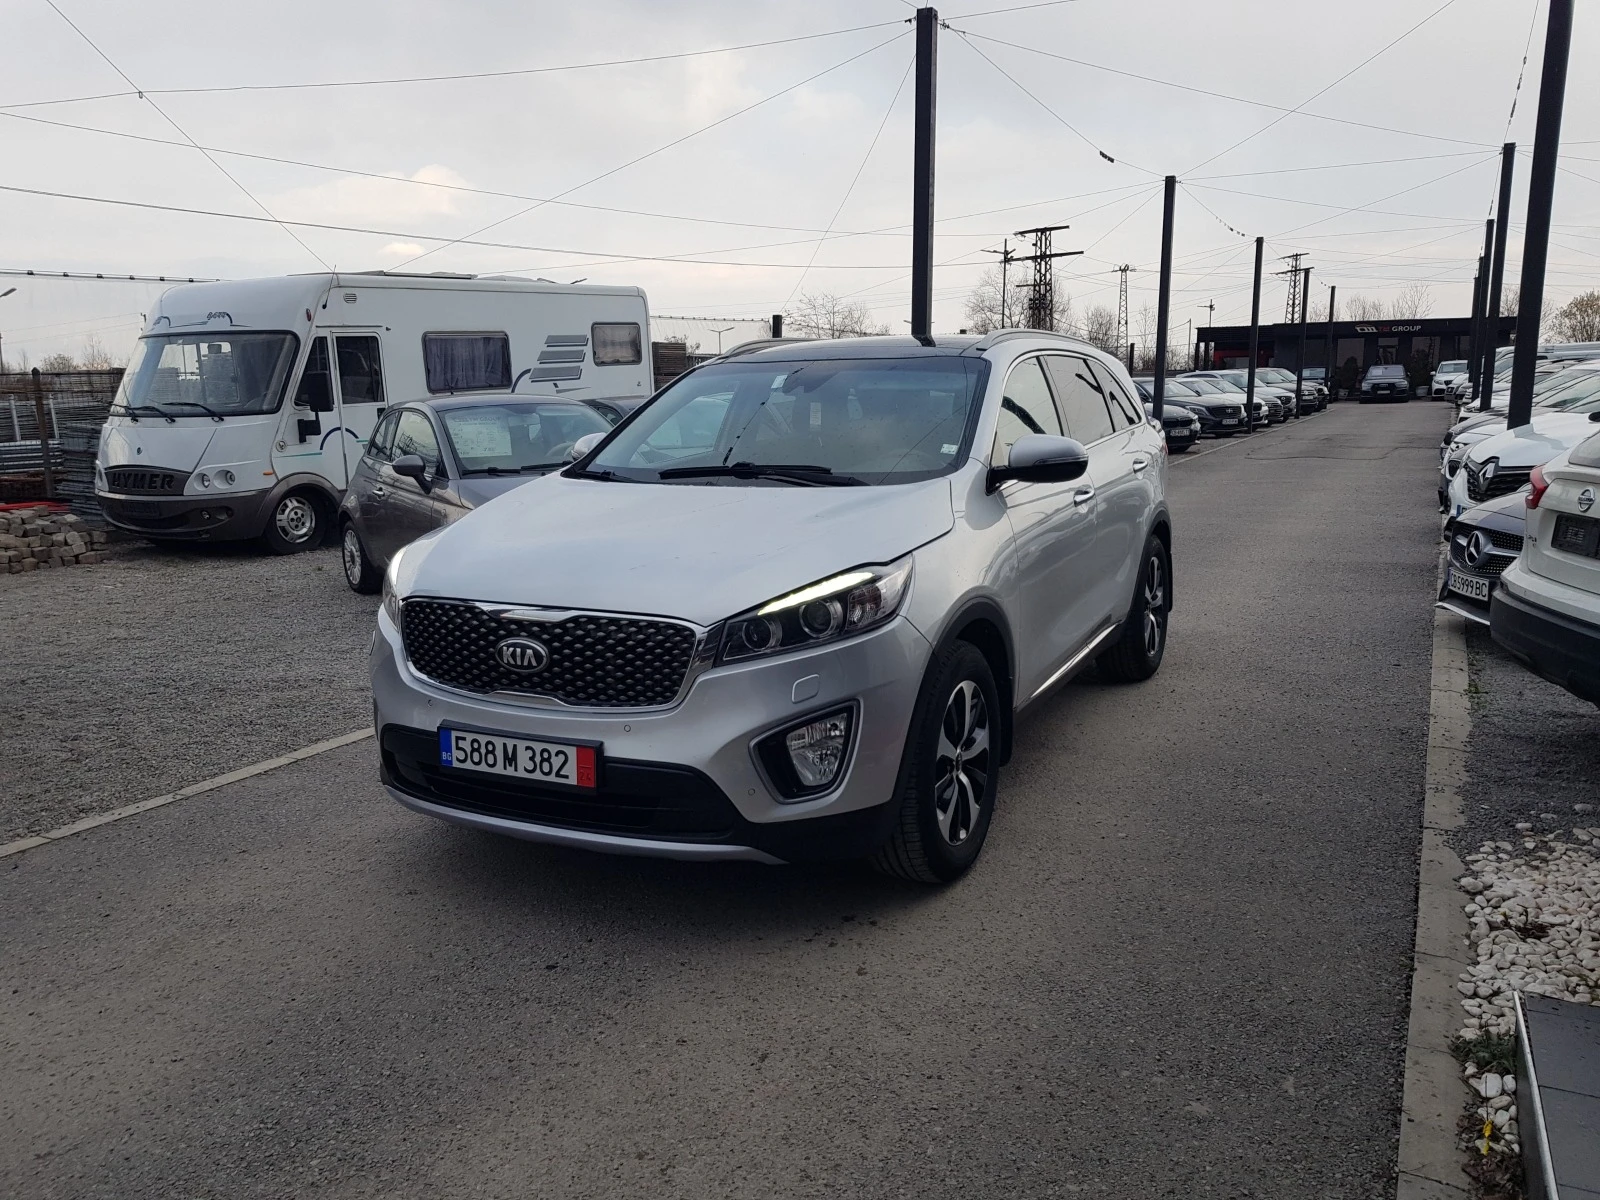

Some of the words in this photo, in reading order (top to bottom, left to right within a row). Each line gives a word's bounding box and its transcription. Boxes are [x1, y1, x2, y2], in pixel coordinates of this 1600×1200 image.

[111, 472, 175, 490] HYMER
[502, 646, 537, 667] KIA
[442, 751, 452, 761] BG
[502, 742, 518, 772] M
